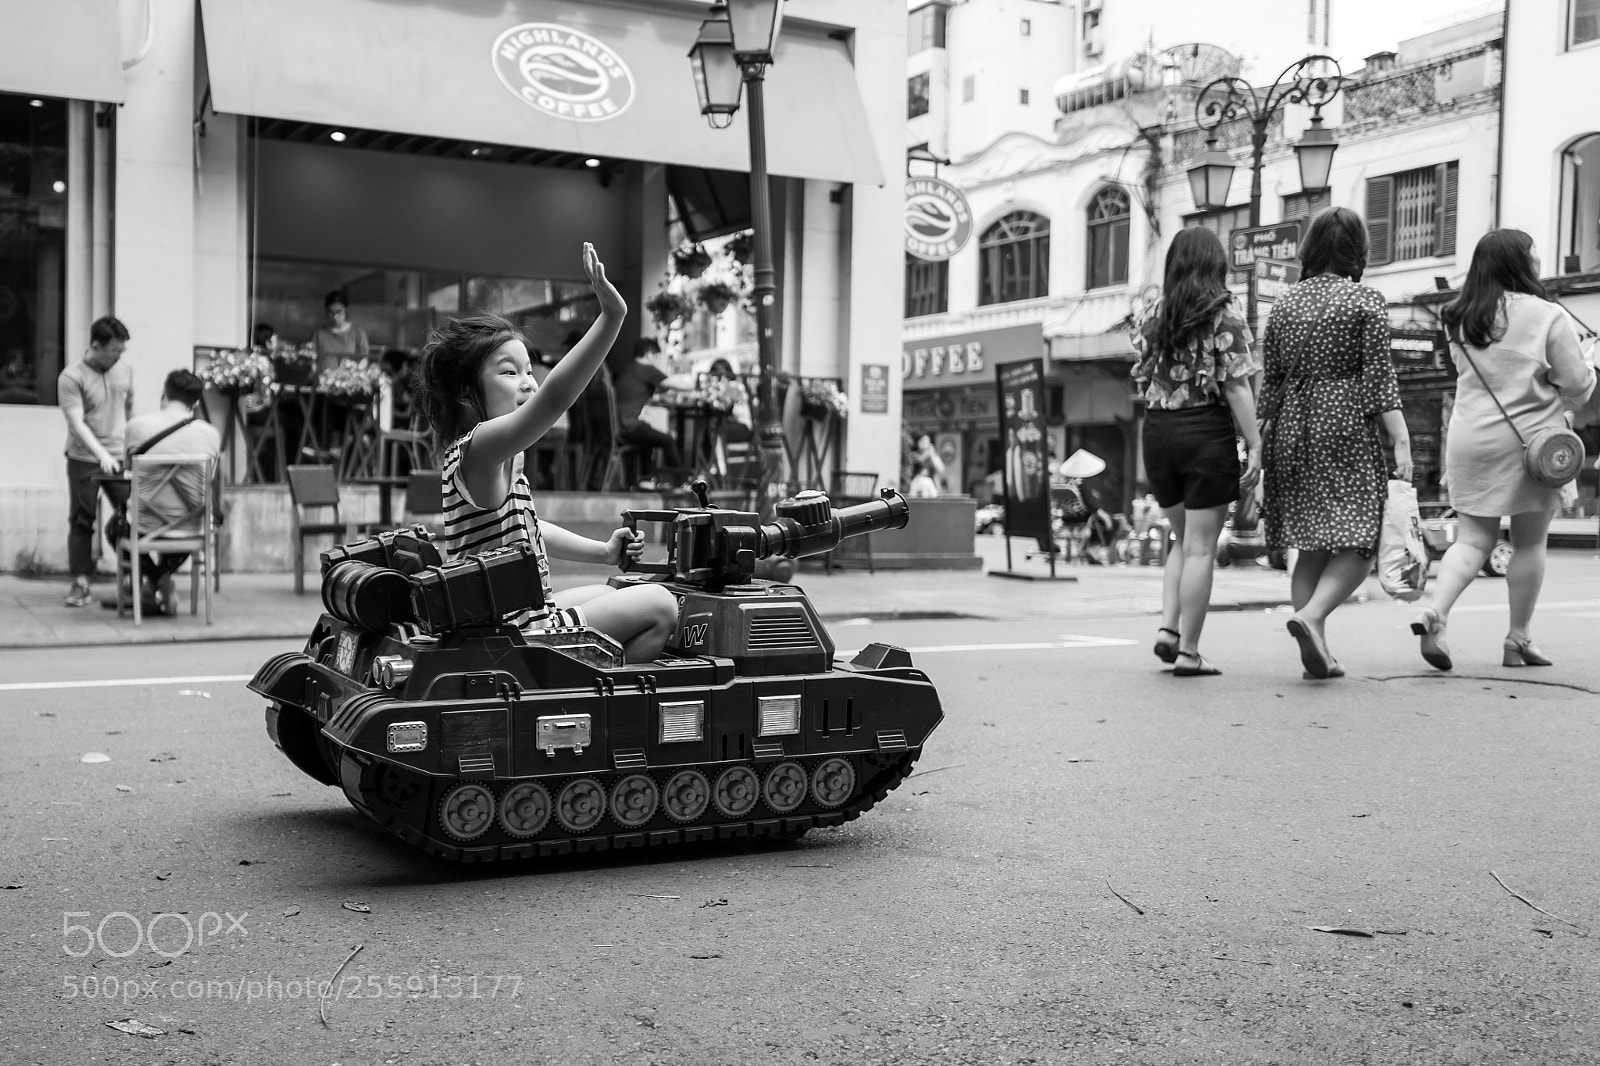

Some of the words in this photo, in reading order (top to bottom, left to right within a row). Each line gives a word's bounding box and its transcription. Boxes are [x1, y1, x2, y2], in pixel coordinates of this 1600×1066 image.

[500, 29, 624, 79] HIGHLANDS
[521, 85, 619, 118] COFFEE
[905, 181, 968, 223] GHLANDS
[905, 237, 958, 256] OFFEE
[902, 341, 984, 379] OFFEE
